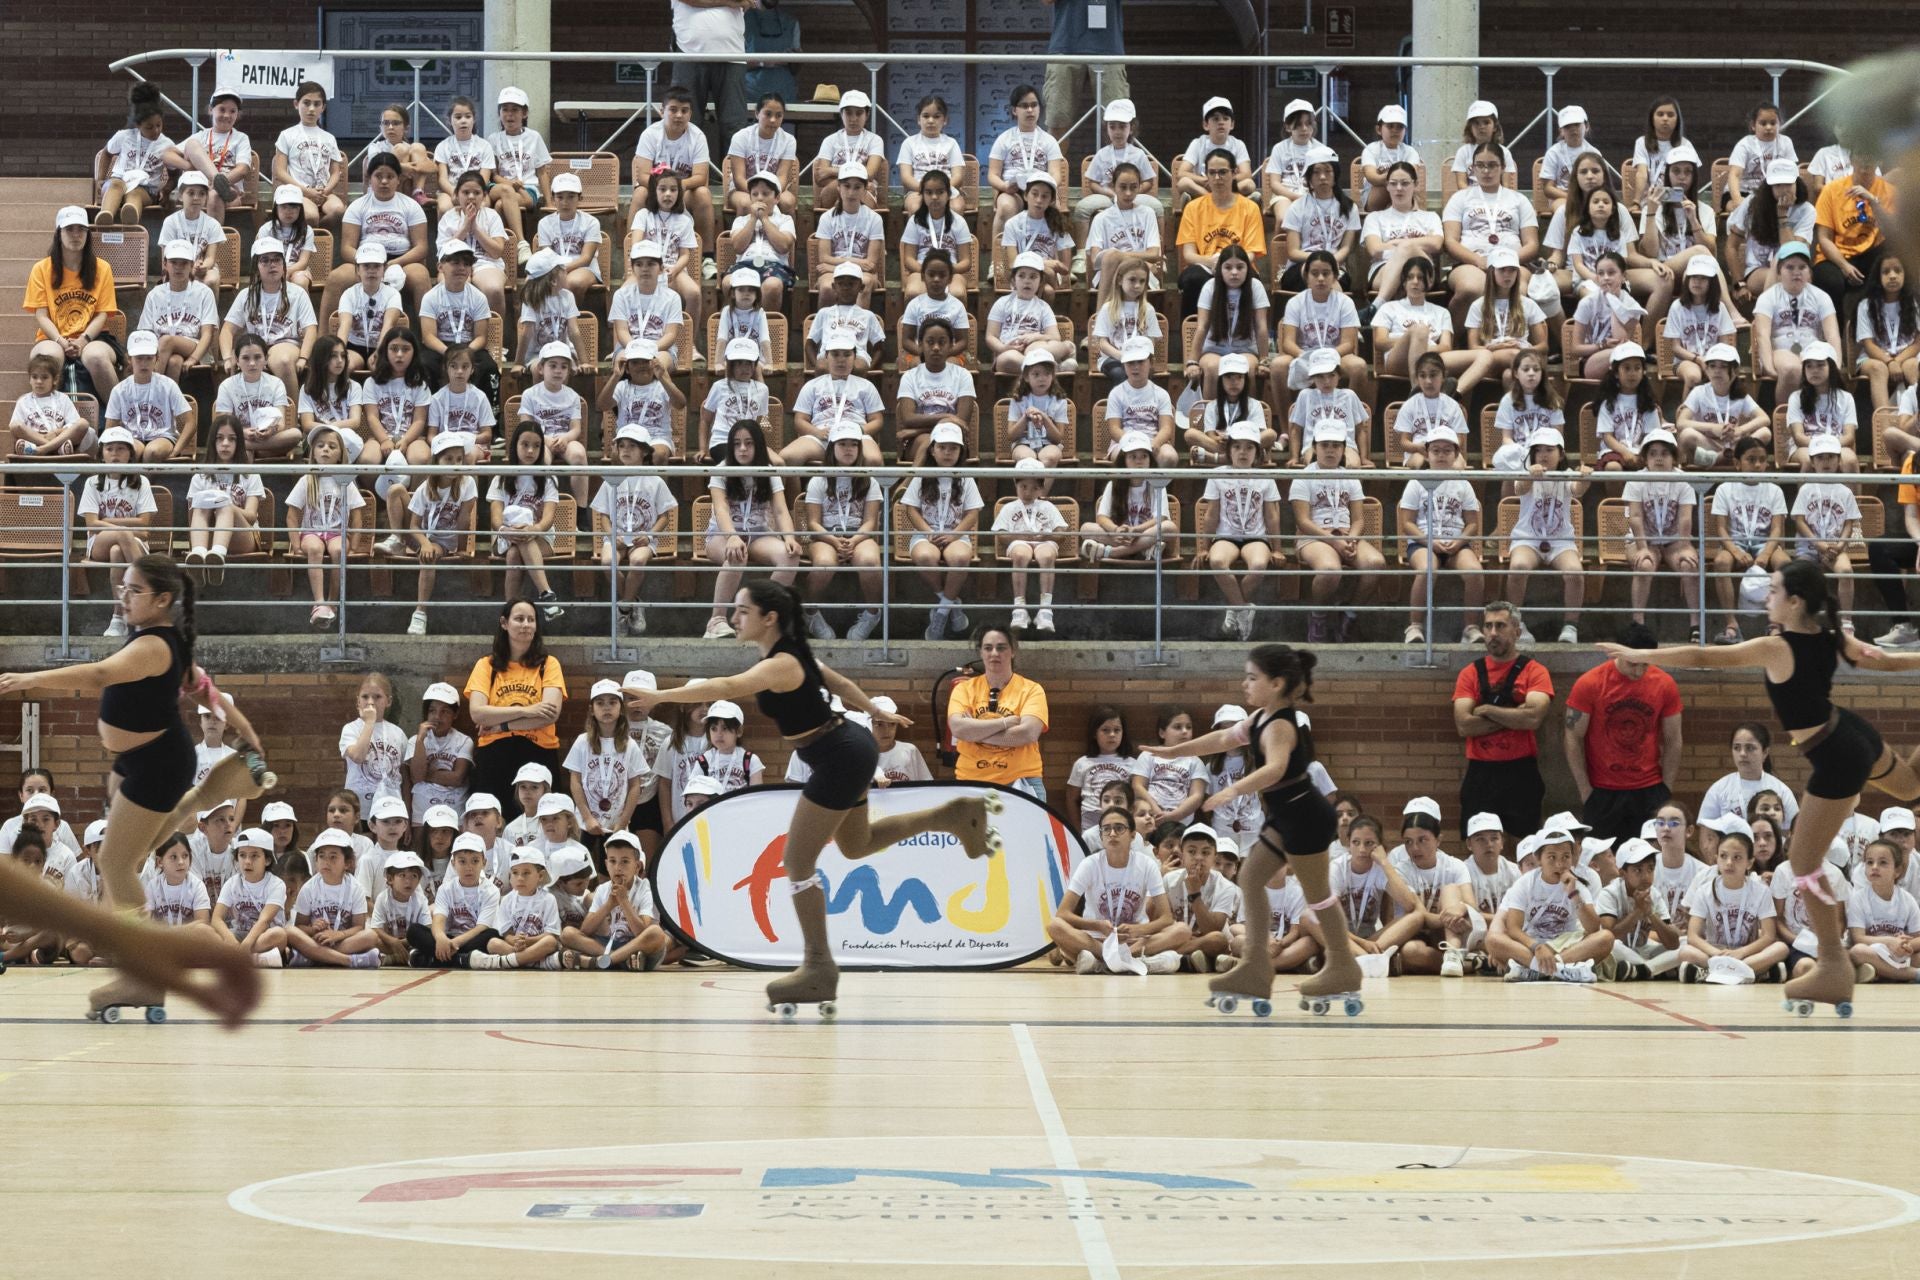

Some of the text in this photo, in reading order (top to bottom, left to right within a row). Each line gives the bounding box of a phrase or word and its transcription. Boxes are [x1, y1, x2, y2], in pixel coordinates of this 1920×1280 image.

[242, 64, 305, 86] PATINAJE
[54, 290, 96, 305] clausura
[617, 495, 651, 509] lausura
[496, 684, 537, 697] clausura
[1091, 763, 1128, 777] clausura
[898, 831, 962, 849] adajo
[842, 938, 1009, 950] Fundación Municipal de Deportes
